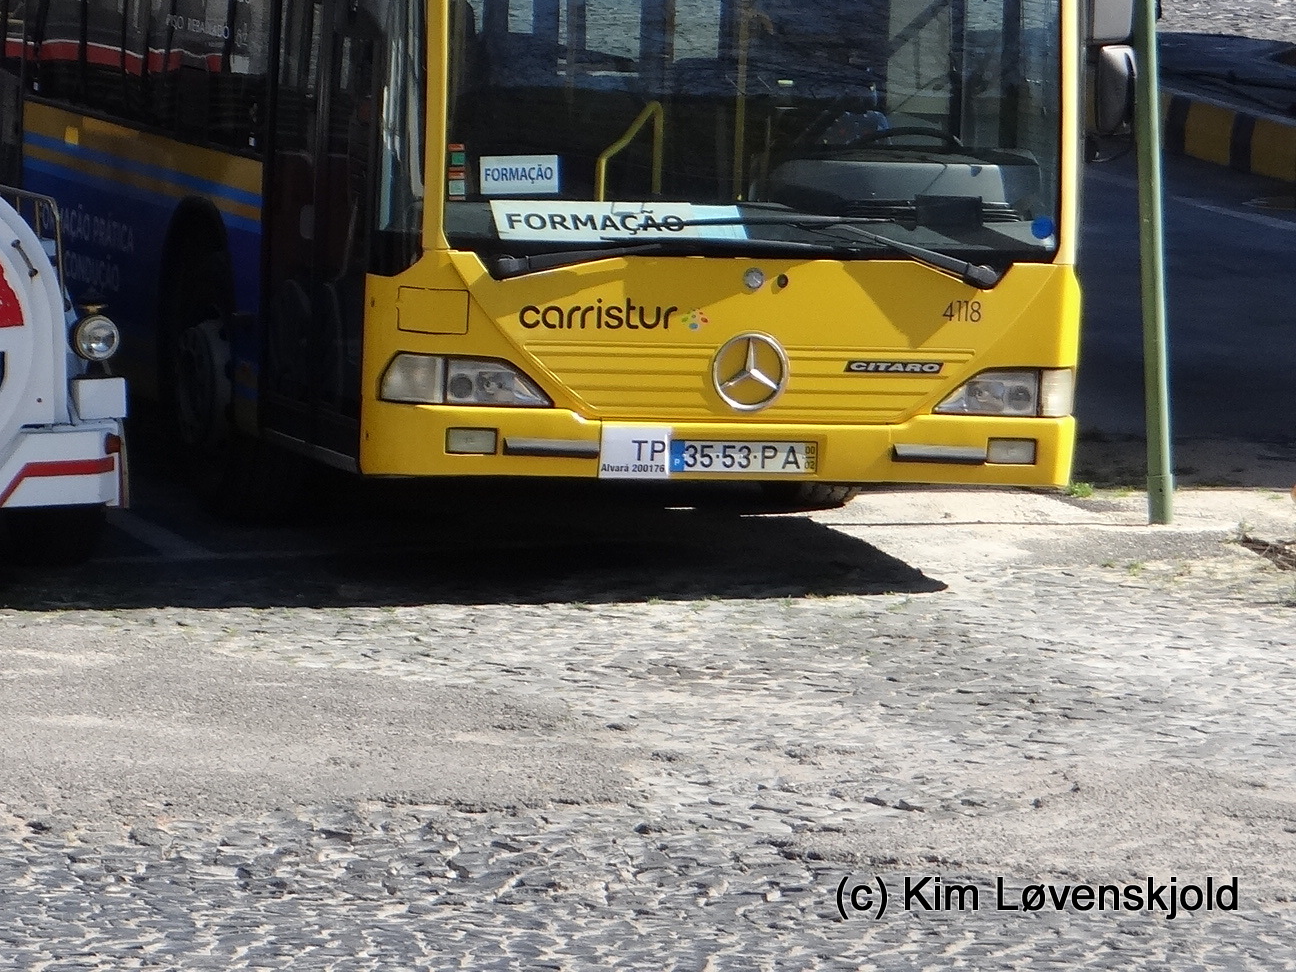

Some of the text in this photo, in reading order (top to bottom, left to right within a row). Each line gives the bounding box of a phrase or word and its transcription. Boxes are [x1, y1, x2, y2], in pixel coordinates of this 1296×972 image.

[484, 163, 554, 185] FORMAÇÃO
[505, 209, 686, 236] FORMAÇÃO
[518, 297, 679, 330] carristur
[942, 300, 982, 323] 4118
[850, 361, 941, 373] CITARO
[631, 439, 666, 462] TP
[601, 463, 630, 473] Alvará
